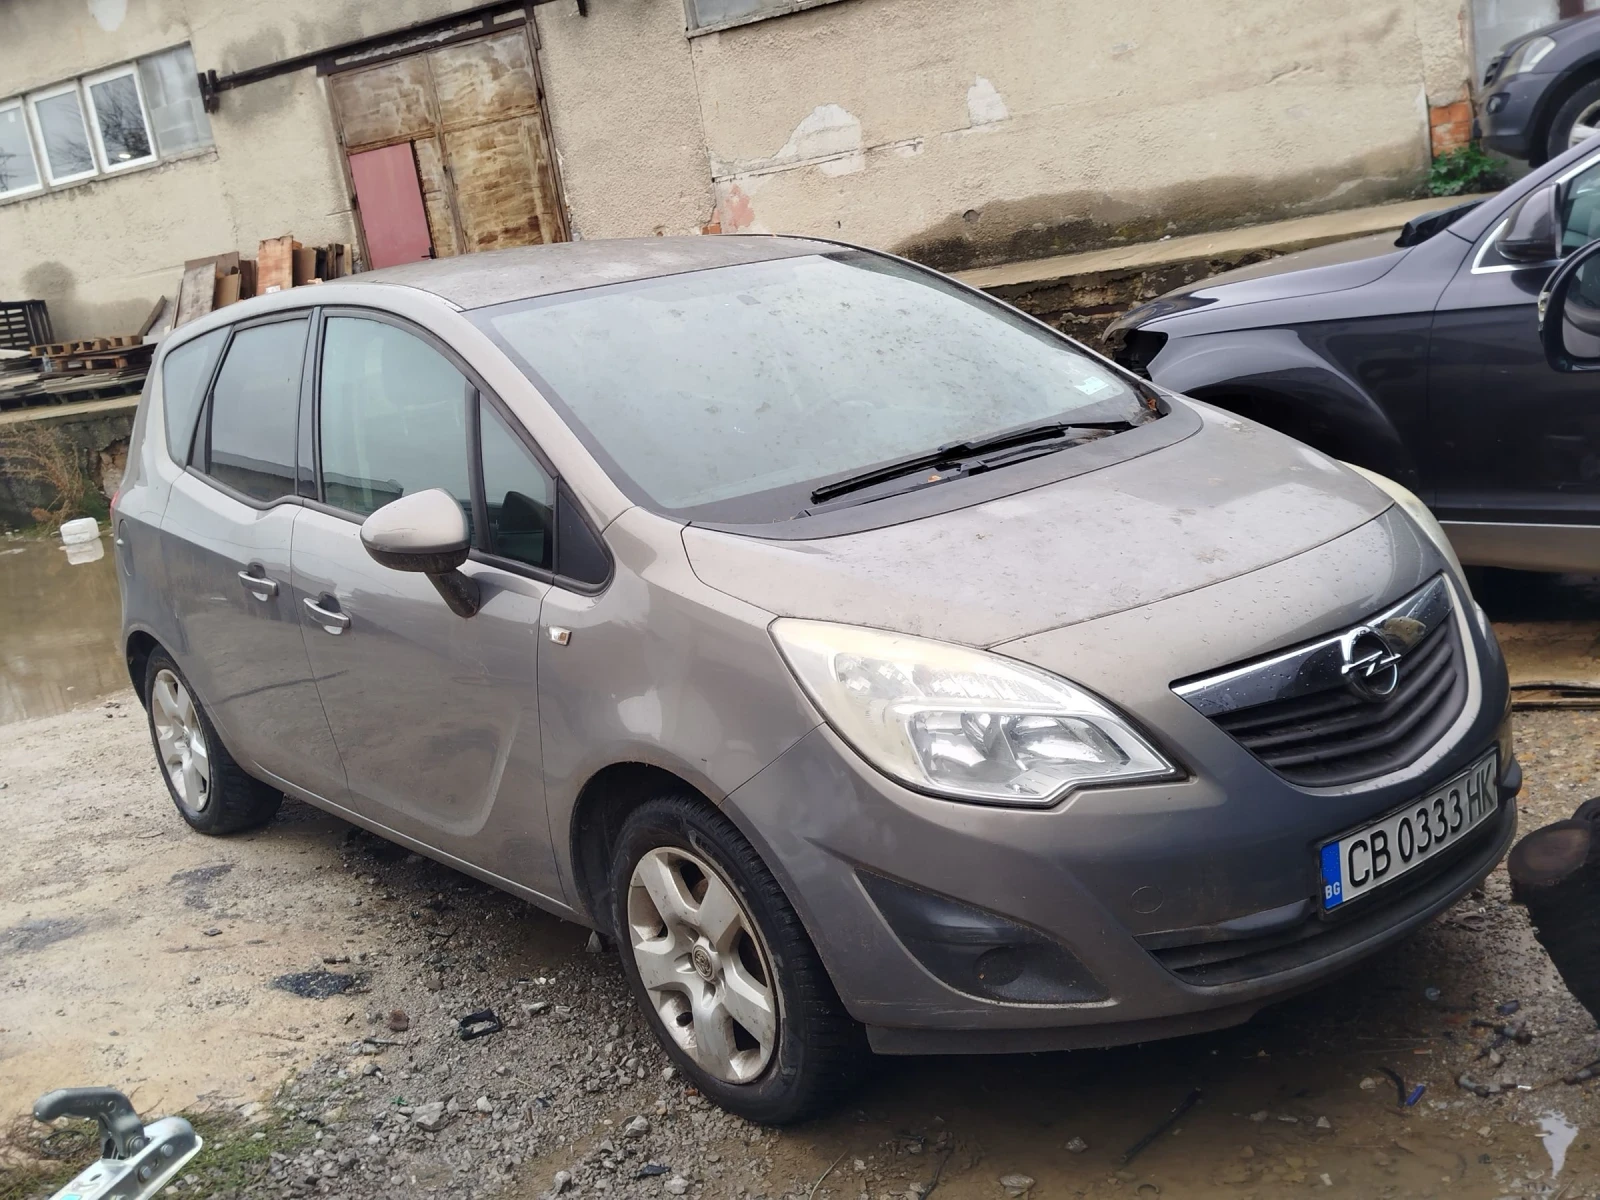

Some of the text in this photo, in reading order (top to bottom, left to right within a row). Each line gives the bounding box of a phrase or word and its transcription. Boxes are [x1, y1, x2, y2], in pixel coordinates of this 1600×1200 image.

[1348, 762, 1494, 888] CB 0333 HK
[1325, 882, 1341, 899] BG
